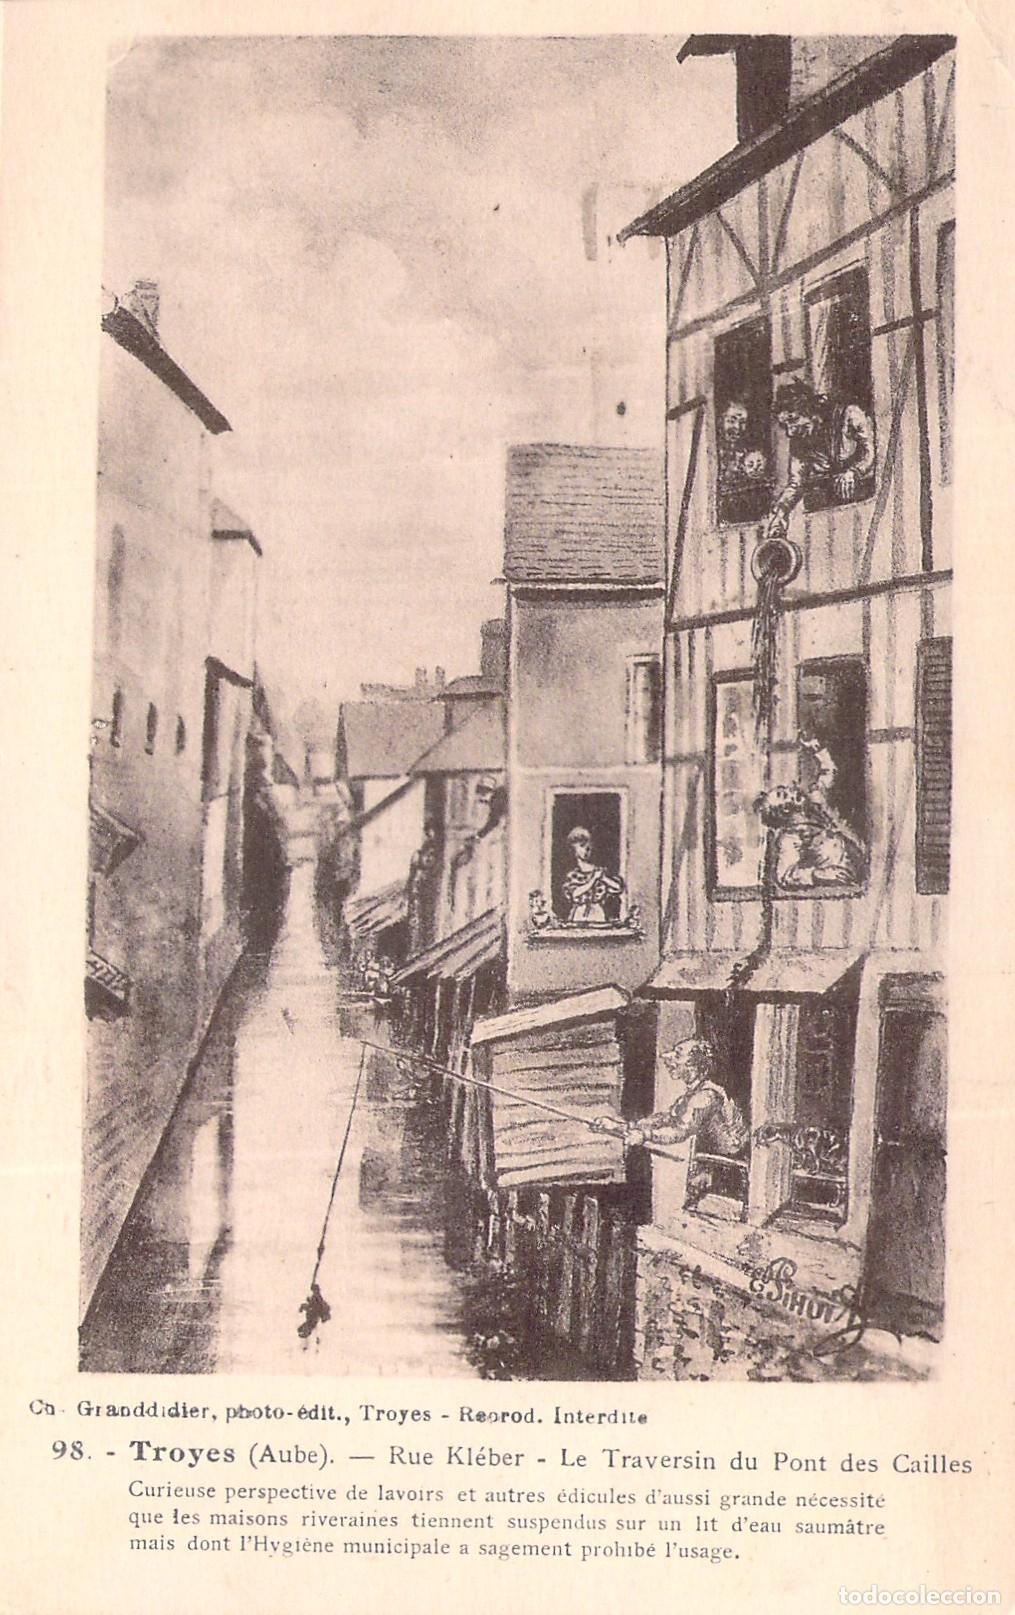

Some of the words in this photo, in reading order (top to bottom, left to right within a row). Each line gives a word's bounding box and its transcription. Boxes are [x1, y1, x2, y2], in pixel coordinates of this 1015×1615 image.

[77, 1401, 217, 1422] Granddidier,
[226, 1404, 350, 1426] photo-édit.,
[359, 1405, 431, 1426] Troyes
[52, 1440, 91, 1460] 98.
[129, 1440, 235, 1468] Troyes
[249, 1443, 334, 1471] (Aube).
[389, 1446, 433, 1465] Rue
[446, 1446, 525, 1466] Kléber
[561, 1448, 587, 1467] Le
[602, 1449, 716, 1470] Traversin
[730, 1451, 758, 1470] du
[774, 1452, 826, 1471] Pont
[841, 1453, 878, 1472] des
[892, 1454, 972, 1474] Cailles
[129, 1480, 216, 1498] Curieuse
[225, 1485, 336, 1504] perspective
[346, 1484, 368, 1500] de
[378, 1484, 443, 1501] lavoirs
[458, 1488, 476, 1502] et
[485, 1488, 545, 1503] autres
[557, 1488, 636, 1504] édicules
[645, 1489, 710, 1505] d'aussi
[720, 1491, 786, 1511] grande
[796, 1492, 885, 1508] nécessité
[129, 1512, 163, 1528] que
[173, 1508, 200, 1525] les
[210, 1509, 288, 1526] maisons
[302, 1510, 398, 1527] riveraines
[411, 1513, 493, 1528] tiennent
[507, 1514, 606, 1534] suspendus
[616, 1519, 646, 1531] sur
[658, 1520, 681, 1531] un
[696, 1516, 718, 1532] lit
[732, 1516, 781, 1533] d'eau
[795, 1519, 885, 1535] saumâtre
[130, 1534, 175, 1550] mais
[188, 1536, 231, 1551] dont
[240, 1535, 334, 1558] l'Hygiène
[344, 1538, 450, 1559] municipale
[459, 1544, 469, 1554] a
[479, 1542, 572, 1560] sagement
[581, 1541, 655, 1561] prohibé
[665, 1542, 739, 1564] l'usage.
